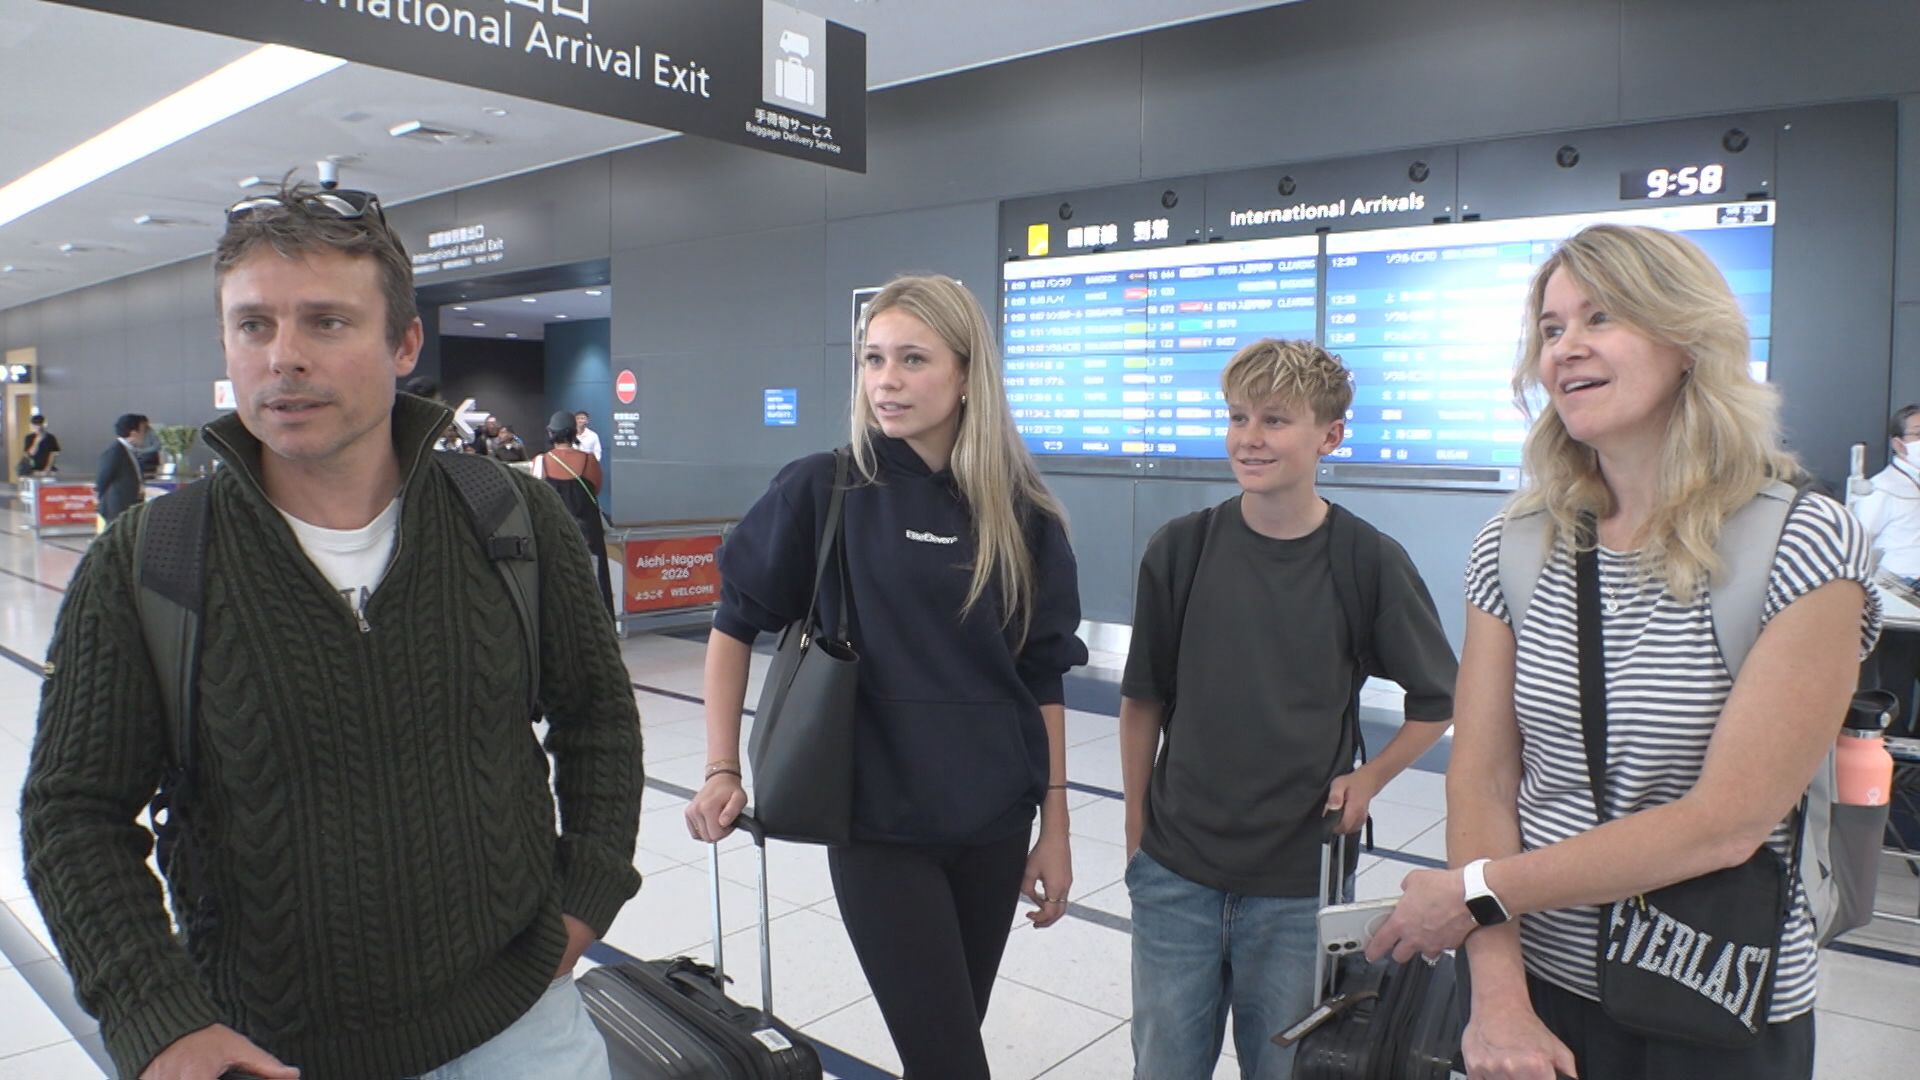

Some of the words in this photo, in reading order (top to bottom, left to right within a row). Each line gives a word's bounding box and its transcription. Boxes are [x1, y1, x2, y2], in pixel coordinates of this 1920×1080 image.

[525, 21, 640, 80] Arrival
[654, 53, 710, 98] Exit
[745, 121, 782, 140] Baggage
[783, 131, 814, 149] Delivery
[815, 140, 841, 154] Service
[755, 108, 832, 140] 手荷物サービス
[1646, 164, 1723, 199] 9:58
[1230, 199, 1344, 227] International
[1350, 191, 1425, 216] Arrivals
[661, 568, 690, 581] 2026
[670, 584, 715, 597] WELCOME
[1606, 898, 1770, 1034] EVERLAST
